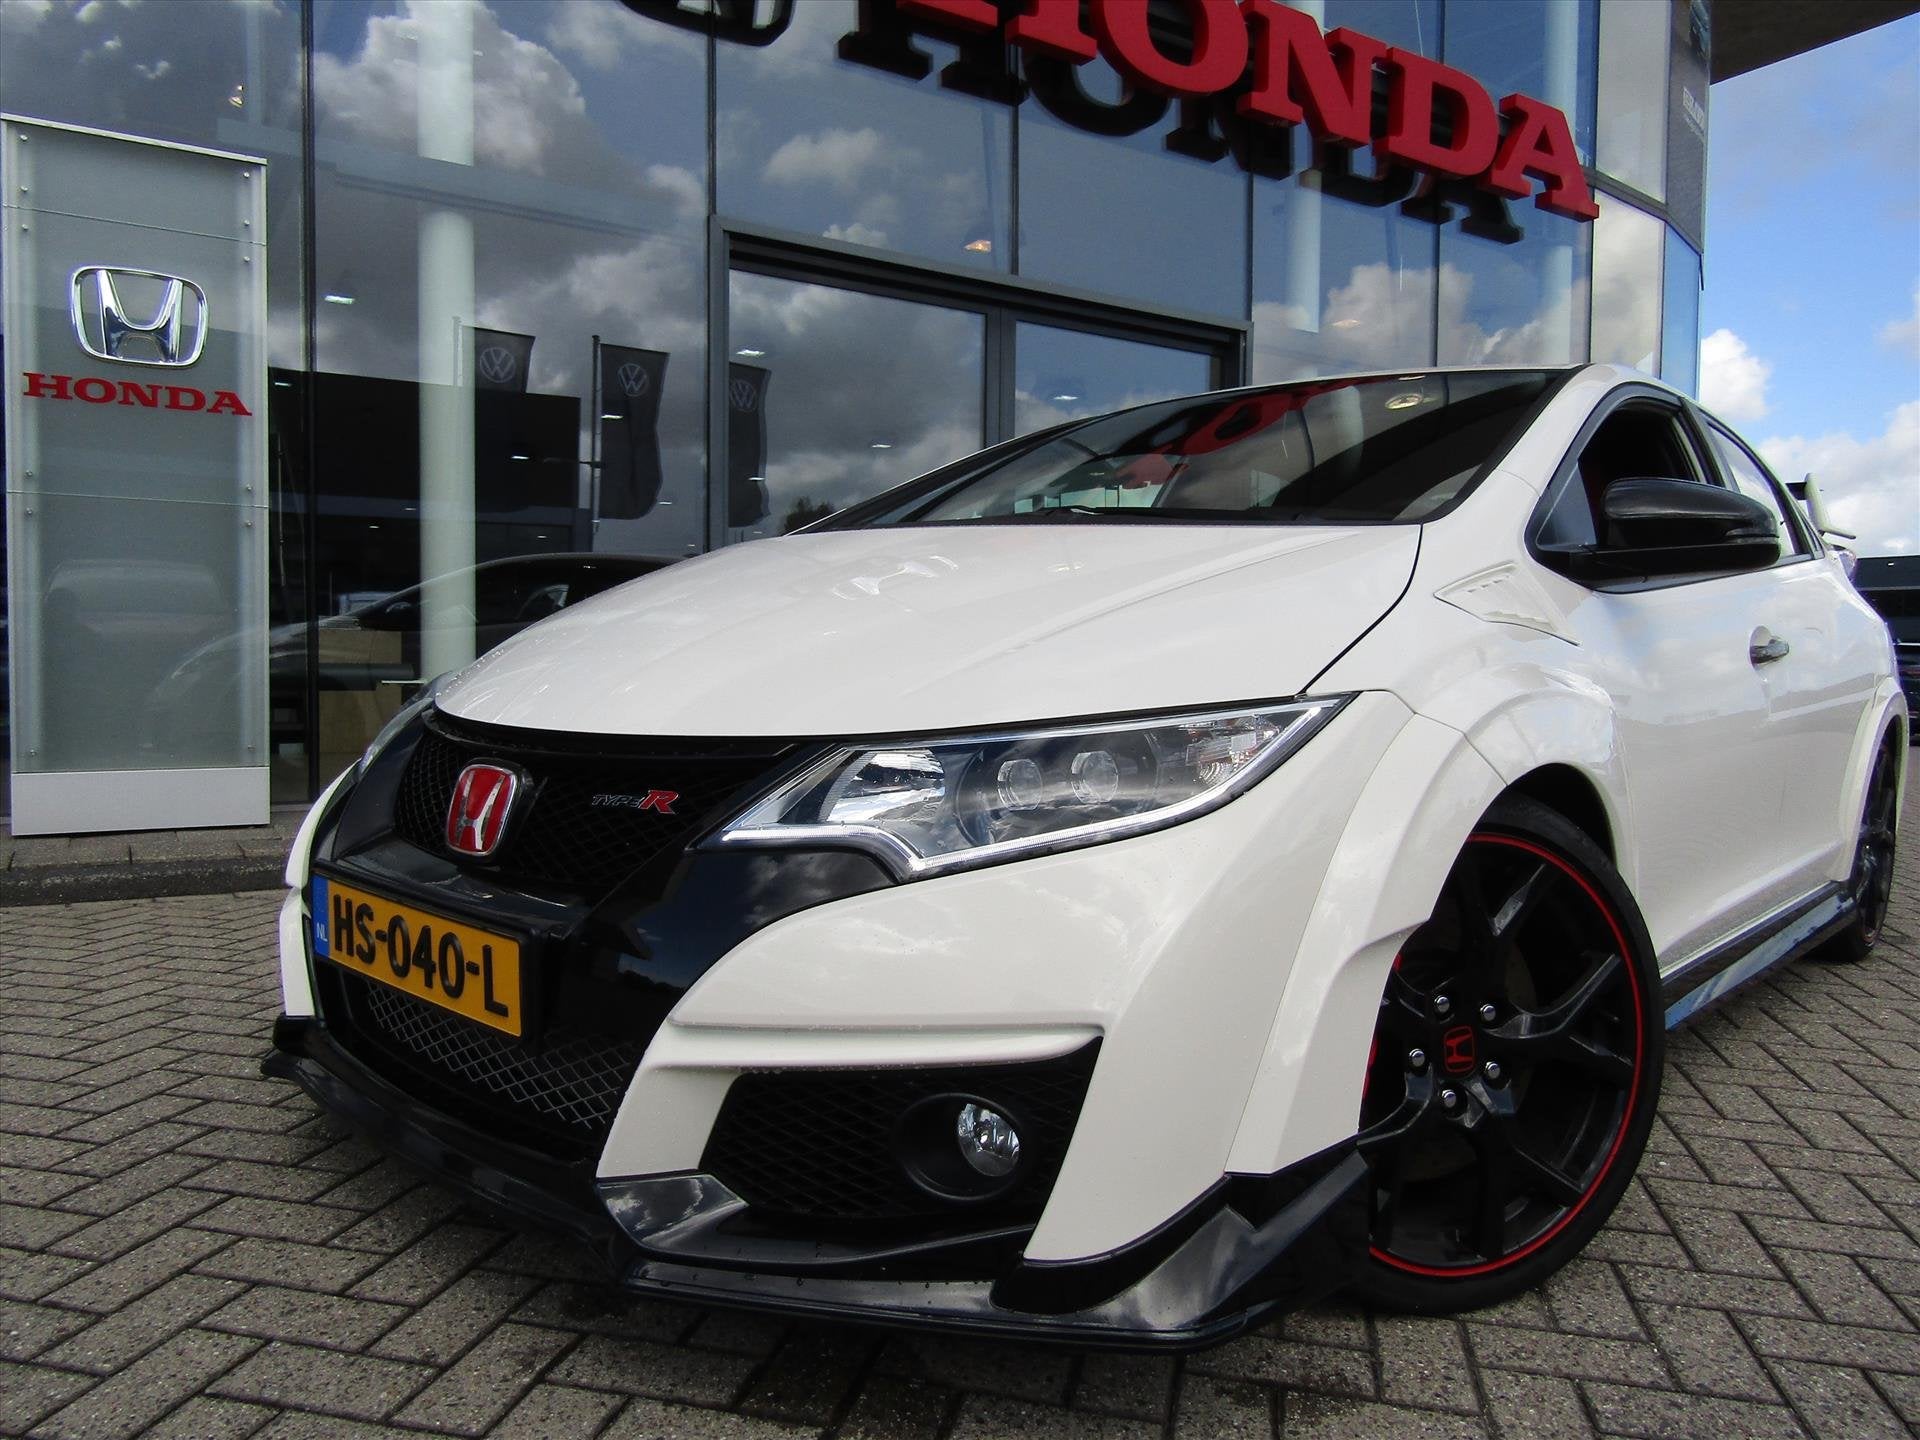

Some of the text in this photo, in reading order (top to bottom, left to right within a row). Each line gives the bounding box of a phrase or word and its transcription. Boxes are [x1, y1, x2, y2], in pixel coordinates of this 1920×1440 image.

[23, 372, 252, 416] HONDA
[316, 922, 328, 942] NL
[333, 894, 509, 1018] HS-040-L
